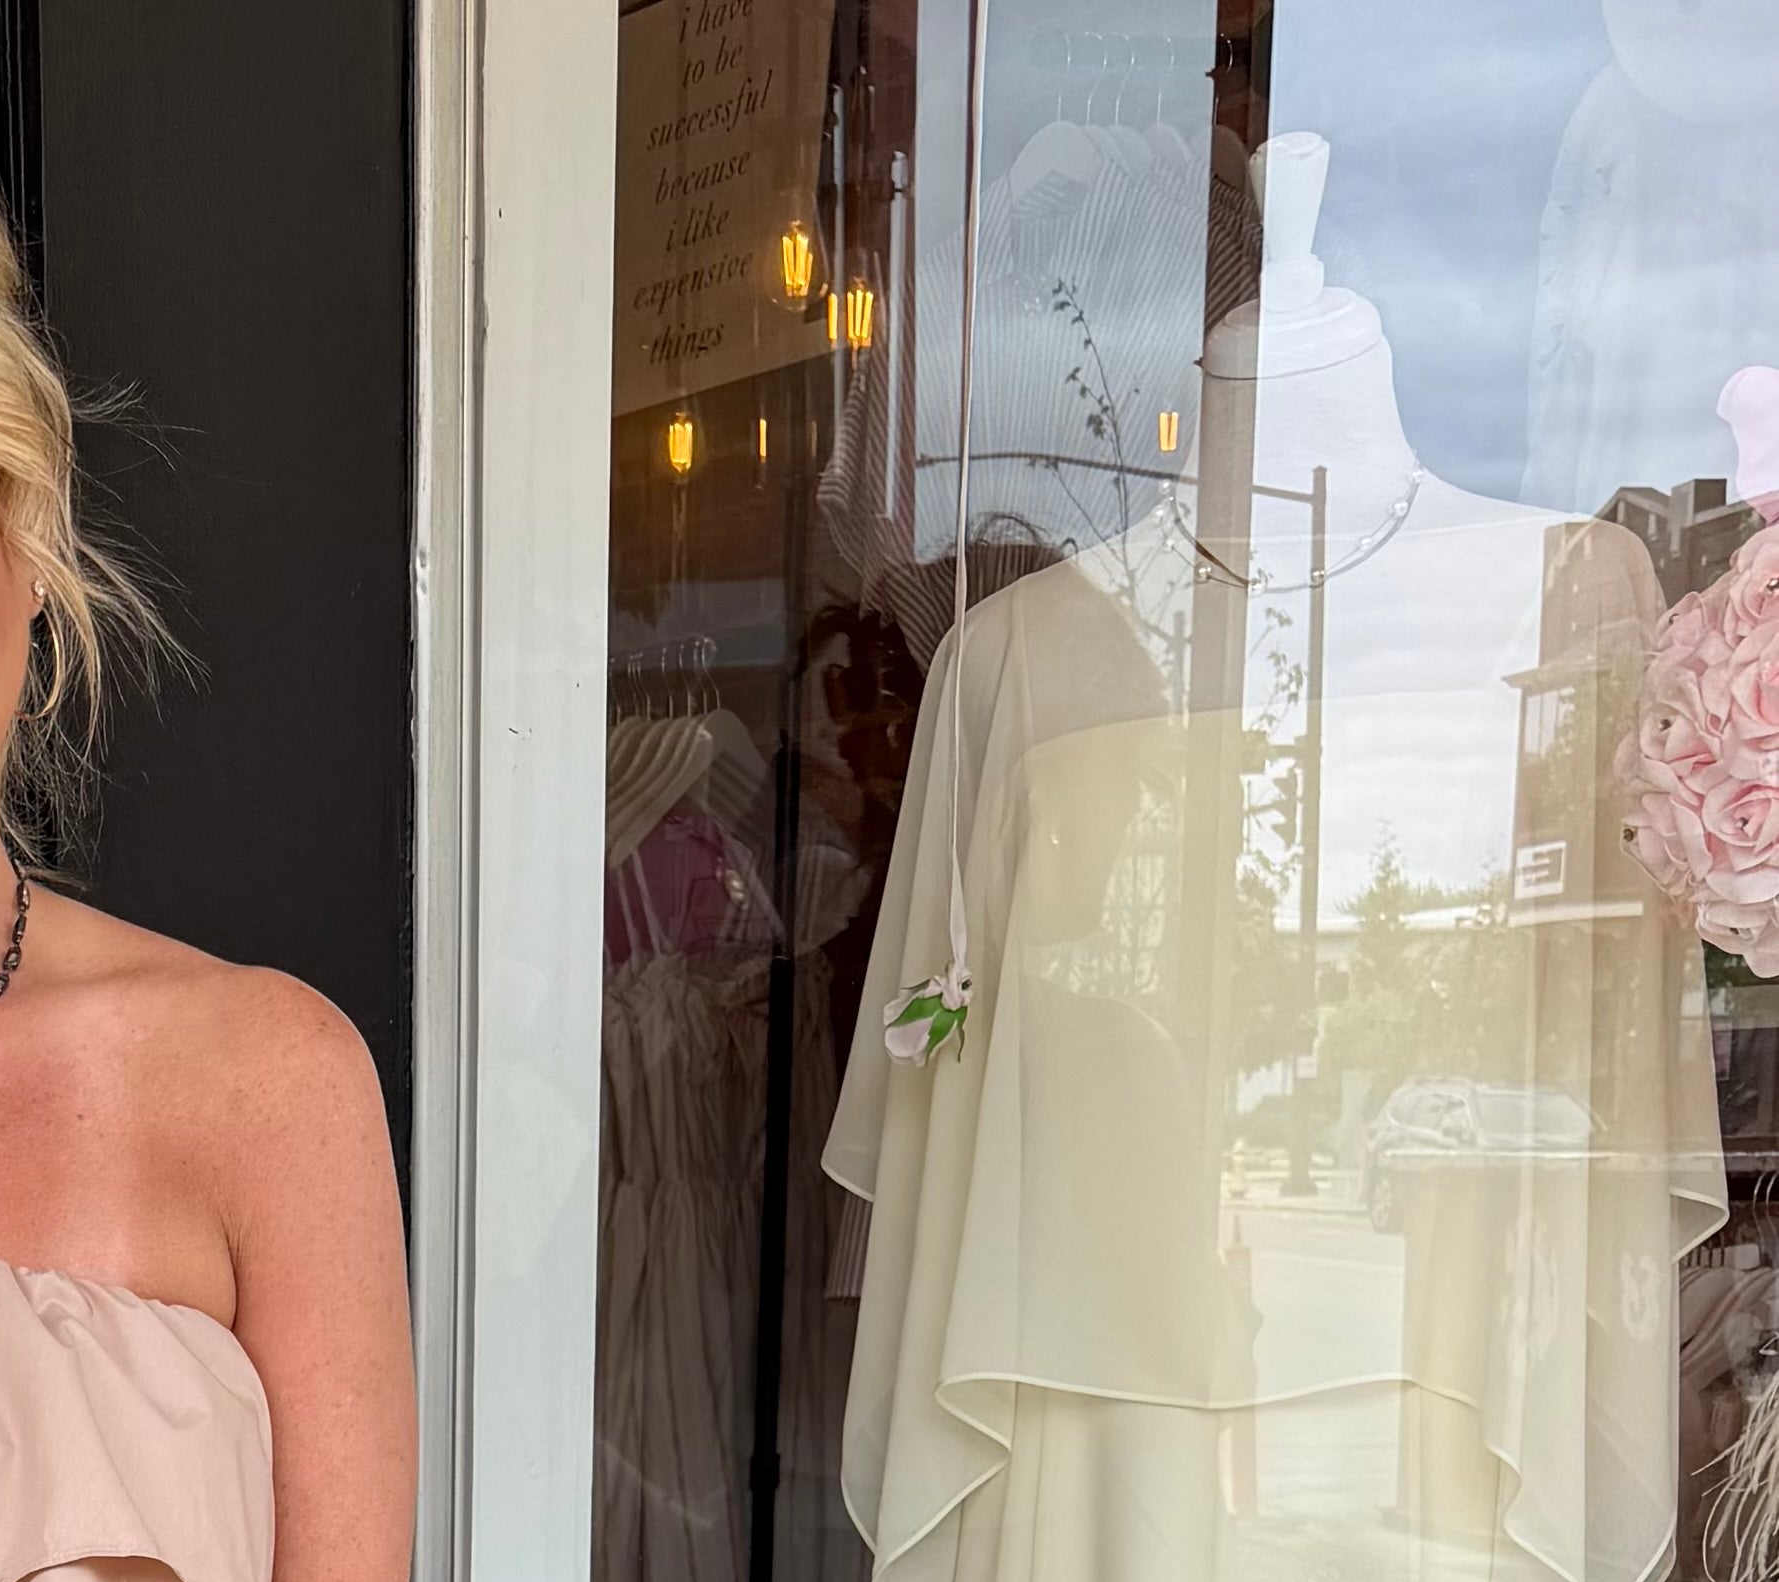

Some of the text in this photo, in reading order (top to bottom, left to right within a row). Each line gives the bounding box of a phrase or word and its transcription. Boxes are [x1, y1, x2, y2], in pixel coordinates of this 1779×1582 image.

[679, 0, 753, 43] i have
[682, 35, 743, 88] to be
[646, 69, 773, 151] successful
[654, 151, 751, 204] because
[666, 201, 730, 252] i like
[633, 252, 754, 316] expensive
[649, 322, 725, 366] things
